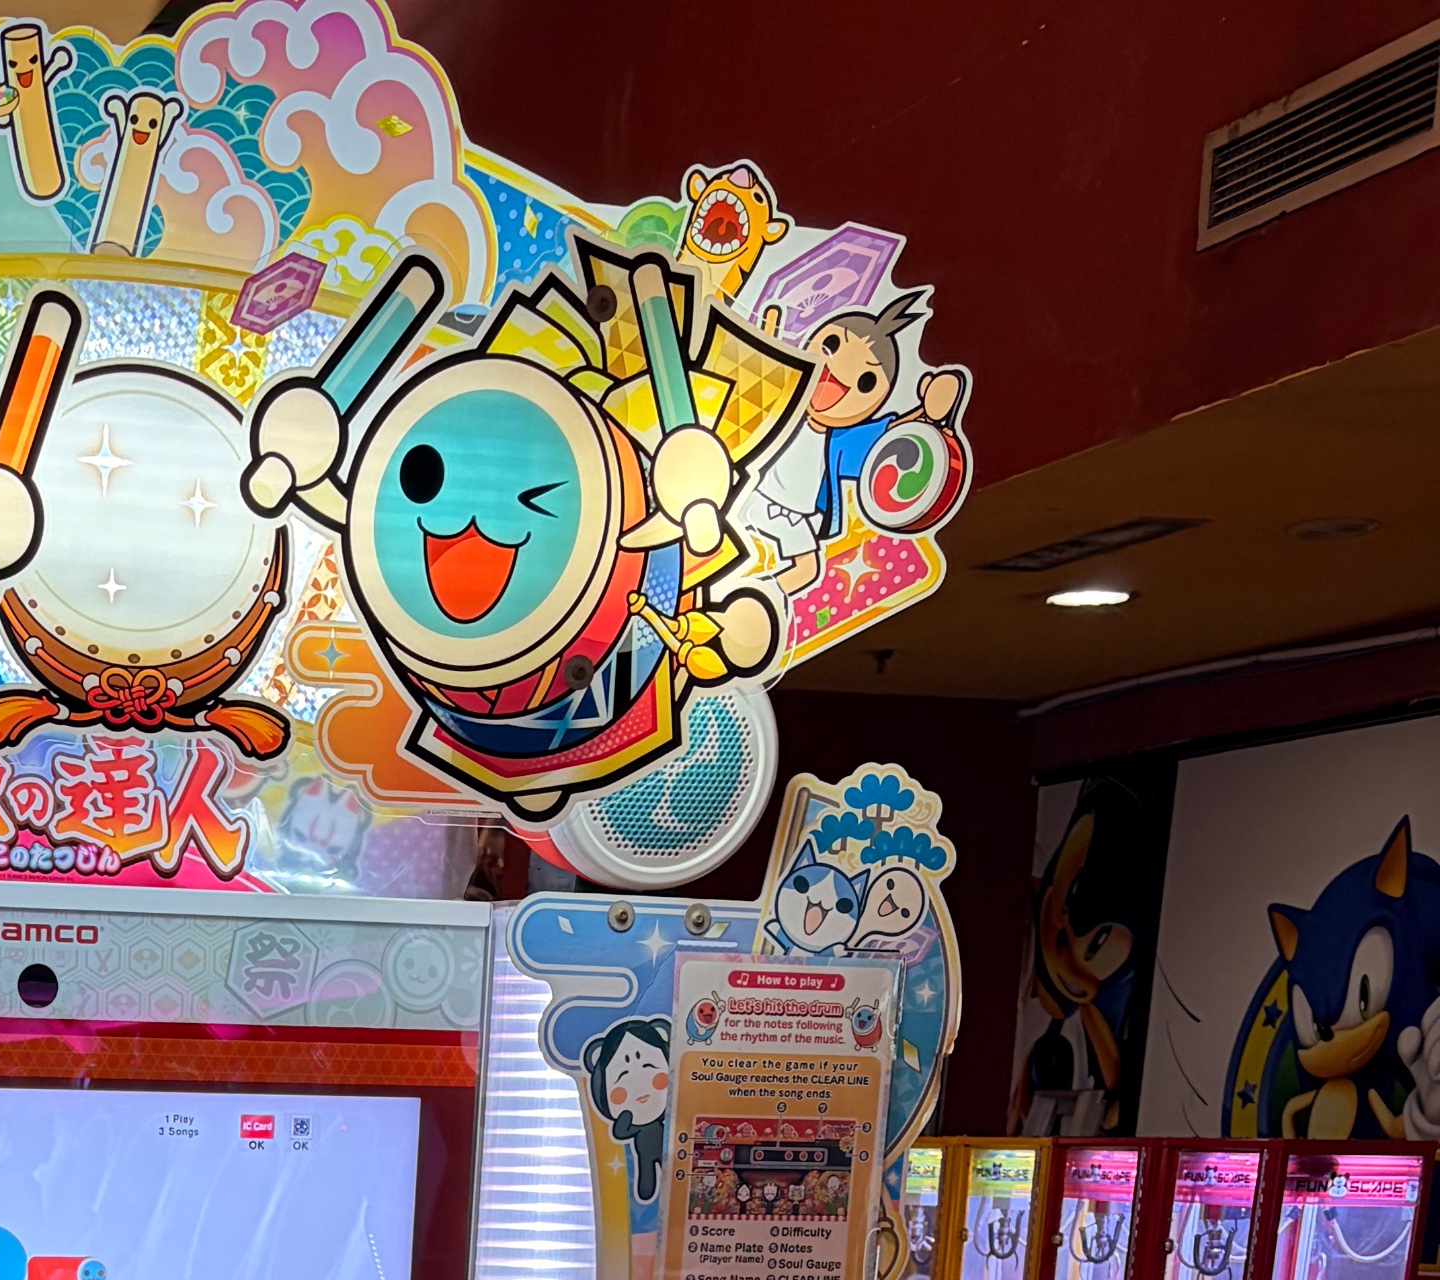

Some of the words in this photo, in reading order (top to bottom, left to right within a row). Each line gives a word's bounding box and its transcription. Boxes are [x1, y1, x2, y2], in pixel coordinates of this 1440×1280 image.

[243, 930, 301, 1000] 祭
[757, 975, 779, 986] How
[785, 976, 795, 987] to
[799, 976, 822, 989] play
[728, 999, 763, 1015] Let's
[765, 999, 783, 1015] hit
[786, 1000, 807, 1016] the
[810, 1001, 843, 1017] drum
[165, 1115, 169, 1124] 1
[173, 1115, 194, 1125] Play
[158, 1128, 164, 1136] 3
[169, 1127, 199, 1137] Songs
[254, 1122, 272, 1131] Card
[249, 1141, 264, 1150] OK
[293, 1142, 308, 1150] OK
[1296, 1180, 1327, 1192] FUN
[1349, 1182, 1403, 1193] SCAPE
[701, 1226, 735, 1237] Score
[782, 1227, 832, 1240] Difficulty
[700, 1243, 729, 1253] Name
[734, 1243, 764, 1253] Plate
[780, 1243, 812, 1254] Notes
[699, 1254, 733, 1266] (Player
[735, 1254, 764, 1265] Name)
[779, 1259, 802, 1269] Soul
[806, 1260, 841, 1272] Gauge
